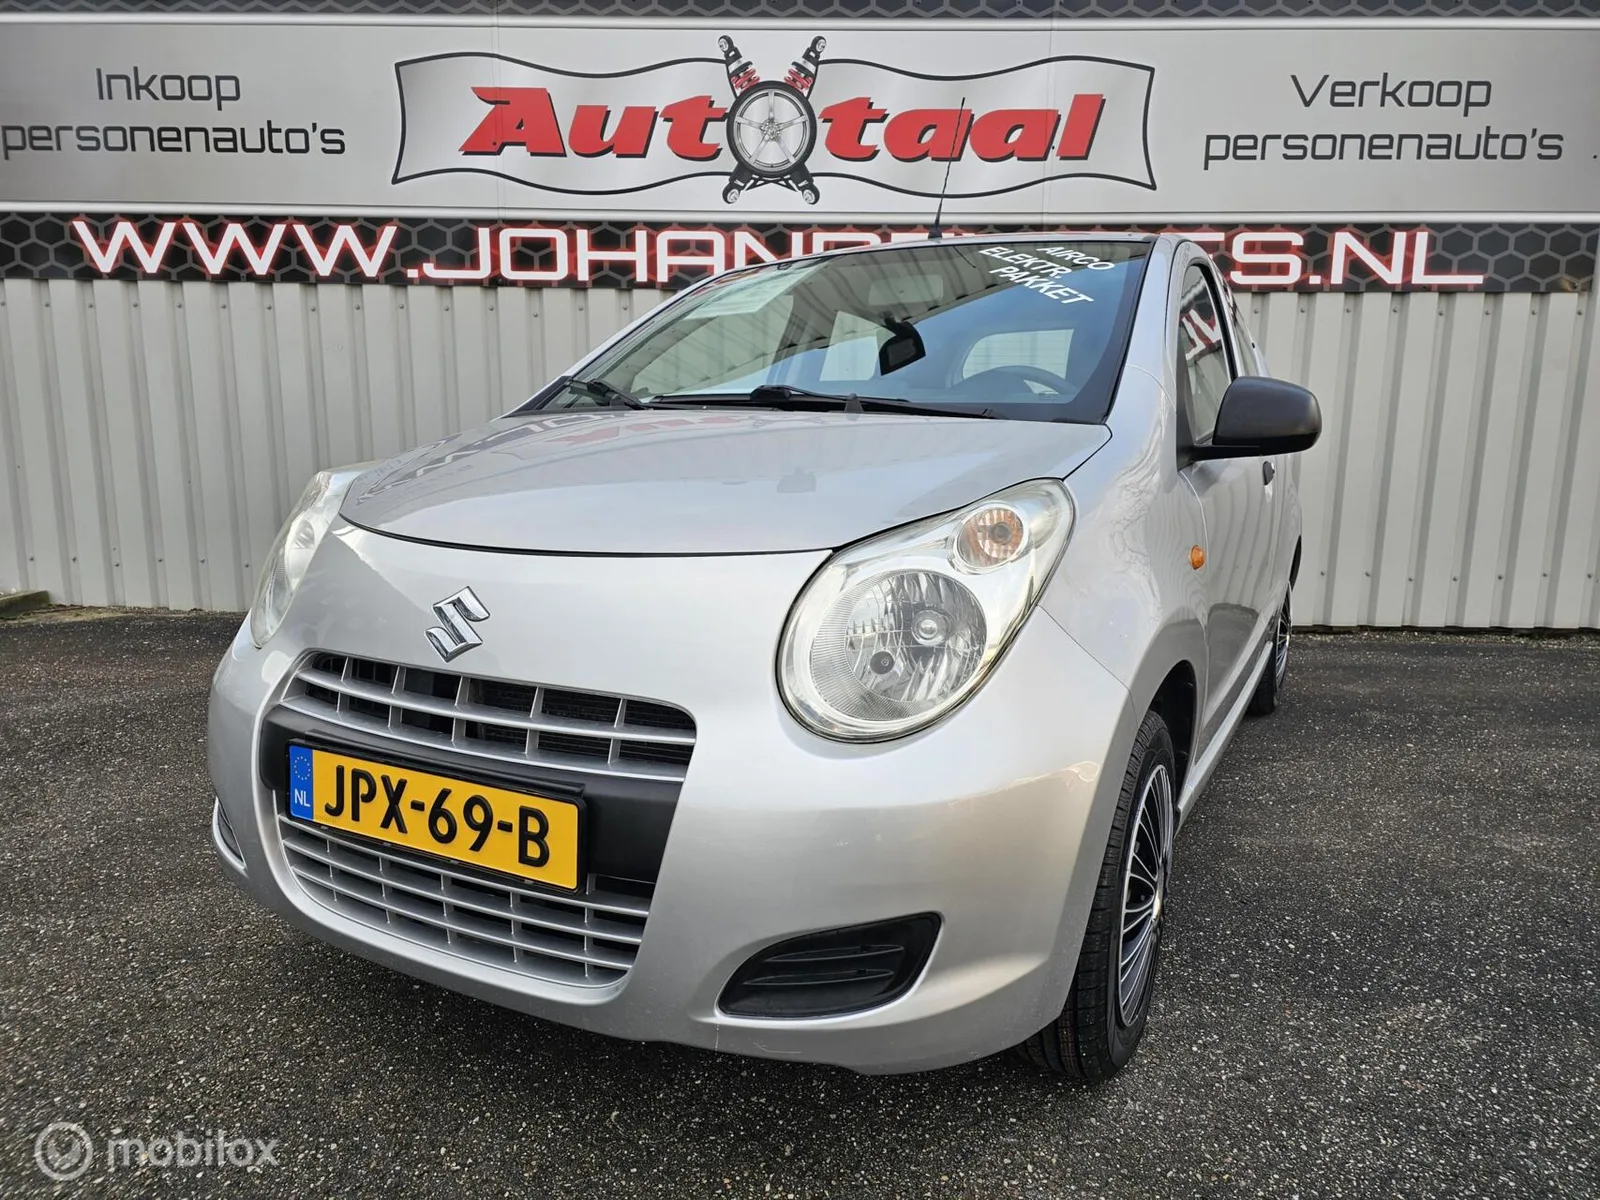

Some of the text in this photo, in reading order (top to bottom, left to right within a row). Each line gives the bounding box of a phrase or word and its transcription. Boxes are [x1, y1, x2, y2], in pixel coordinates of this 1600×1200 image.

[96, 66, 241, 111] Inkoop
[1290, 72, 1493, 117] Verkoop
[2, 120, 347, 160] personenauto's
[1203, 126, 1564, 170] personenauto's
[978, 246, 1073, 280] ELEKTR.
[1034, 246, 1115, 271] AIRCO
[988, 266, 1095, 306] PAKKET
[294, 764, 551, 868] NL JPX-69-B
